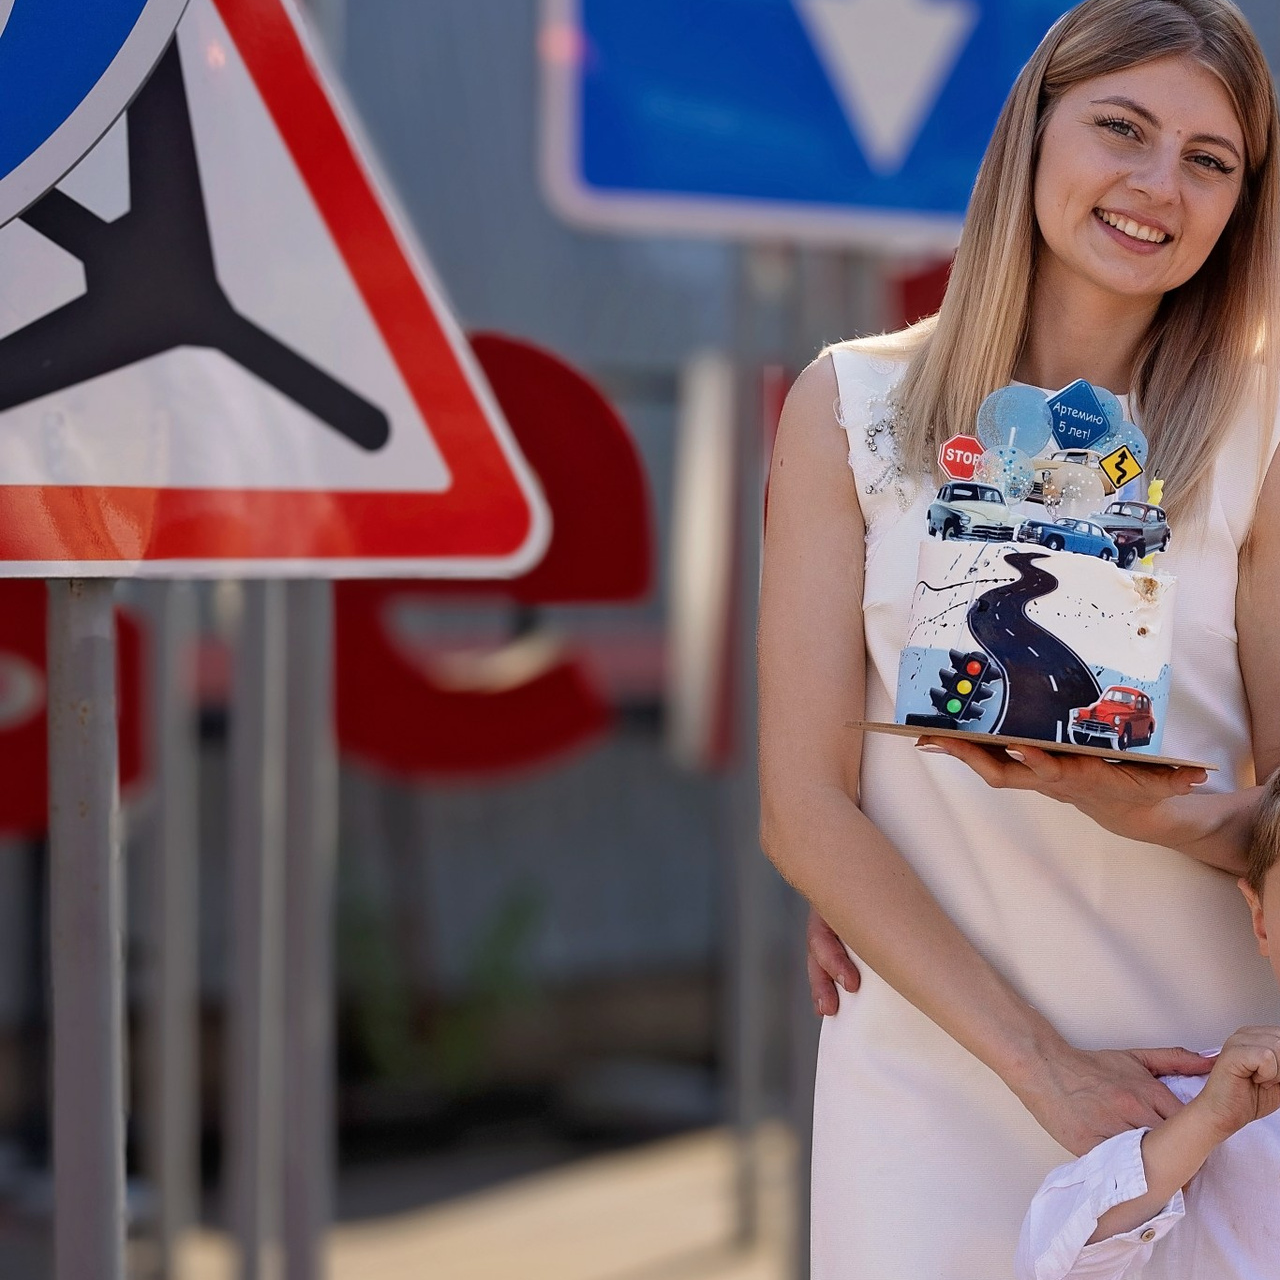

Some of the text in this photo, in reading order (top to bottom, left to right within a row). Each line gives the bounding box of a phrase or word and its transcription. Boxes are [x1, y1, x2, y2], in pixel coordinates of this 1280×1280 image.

[1053, 401, 1104, 425] Артемию
[1058, 421, 1091, 441] 5 лет!
[946, 448, 982, 466] STOP
